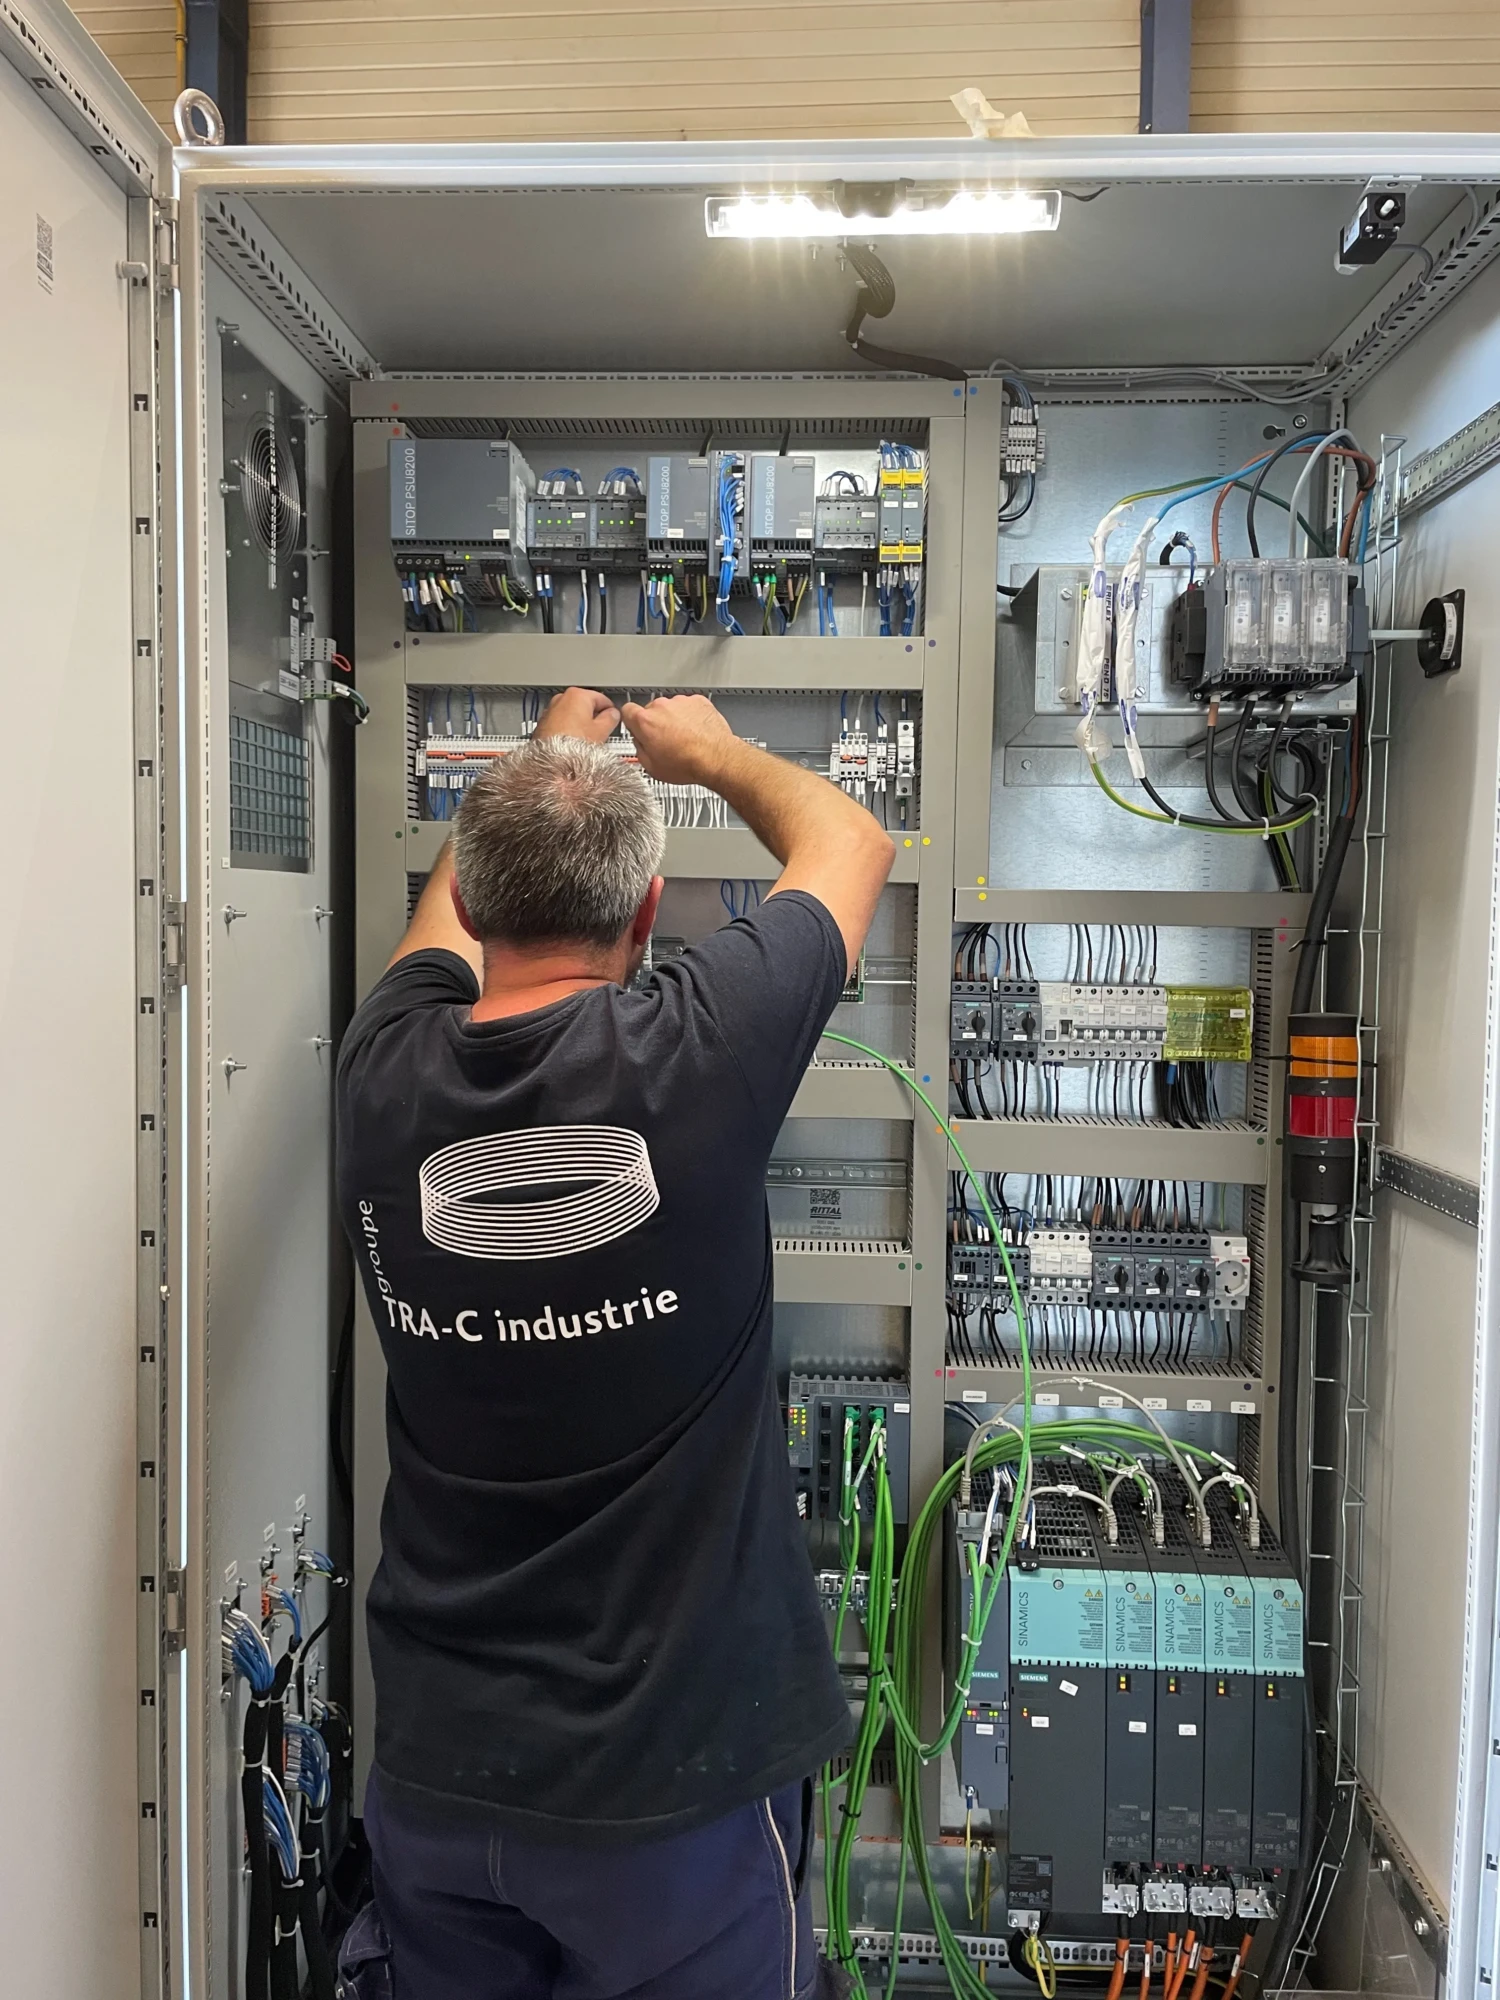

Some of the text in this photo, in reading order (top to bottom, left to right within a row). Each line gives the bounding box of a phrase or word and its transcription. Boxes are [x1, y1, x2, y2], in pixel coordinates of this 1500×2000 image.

[404, 448, 416, 536] SITOP PSU8200
[660, 466, 670, 535] SITOP PSU8200
[764, 465, 775, 535] SITOP PSU8200
[810, 1206, 842, 1215] RITTAL
[358, 1200, 393, 1294] groupe
[382, 1287, 679, 1342] TRA-C industrie
[1018, 1591, 1029, 1647] SINAMICS
[1115, 1596, 1126, 1652] SINAMICS
[1164, 1598, 1175, 1654] SINAMICS
[1213, 1601, 1224, 1656] SINAMICS
[1263, 1603, 1274, 1659] SINAMICS
